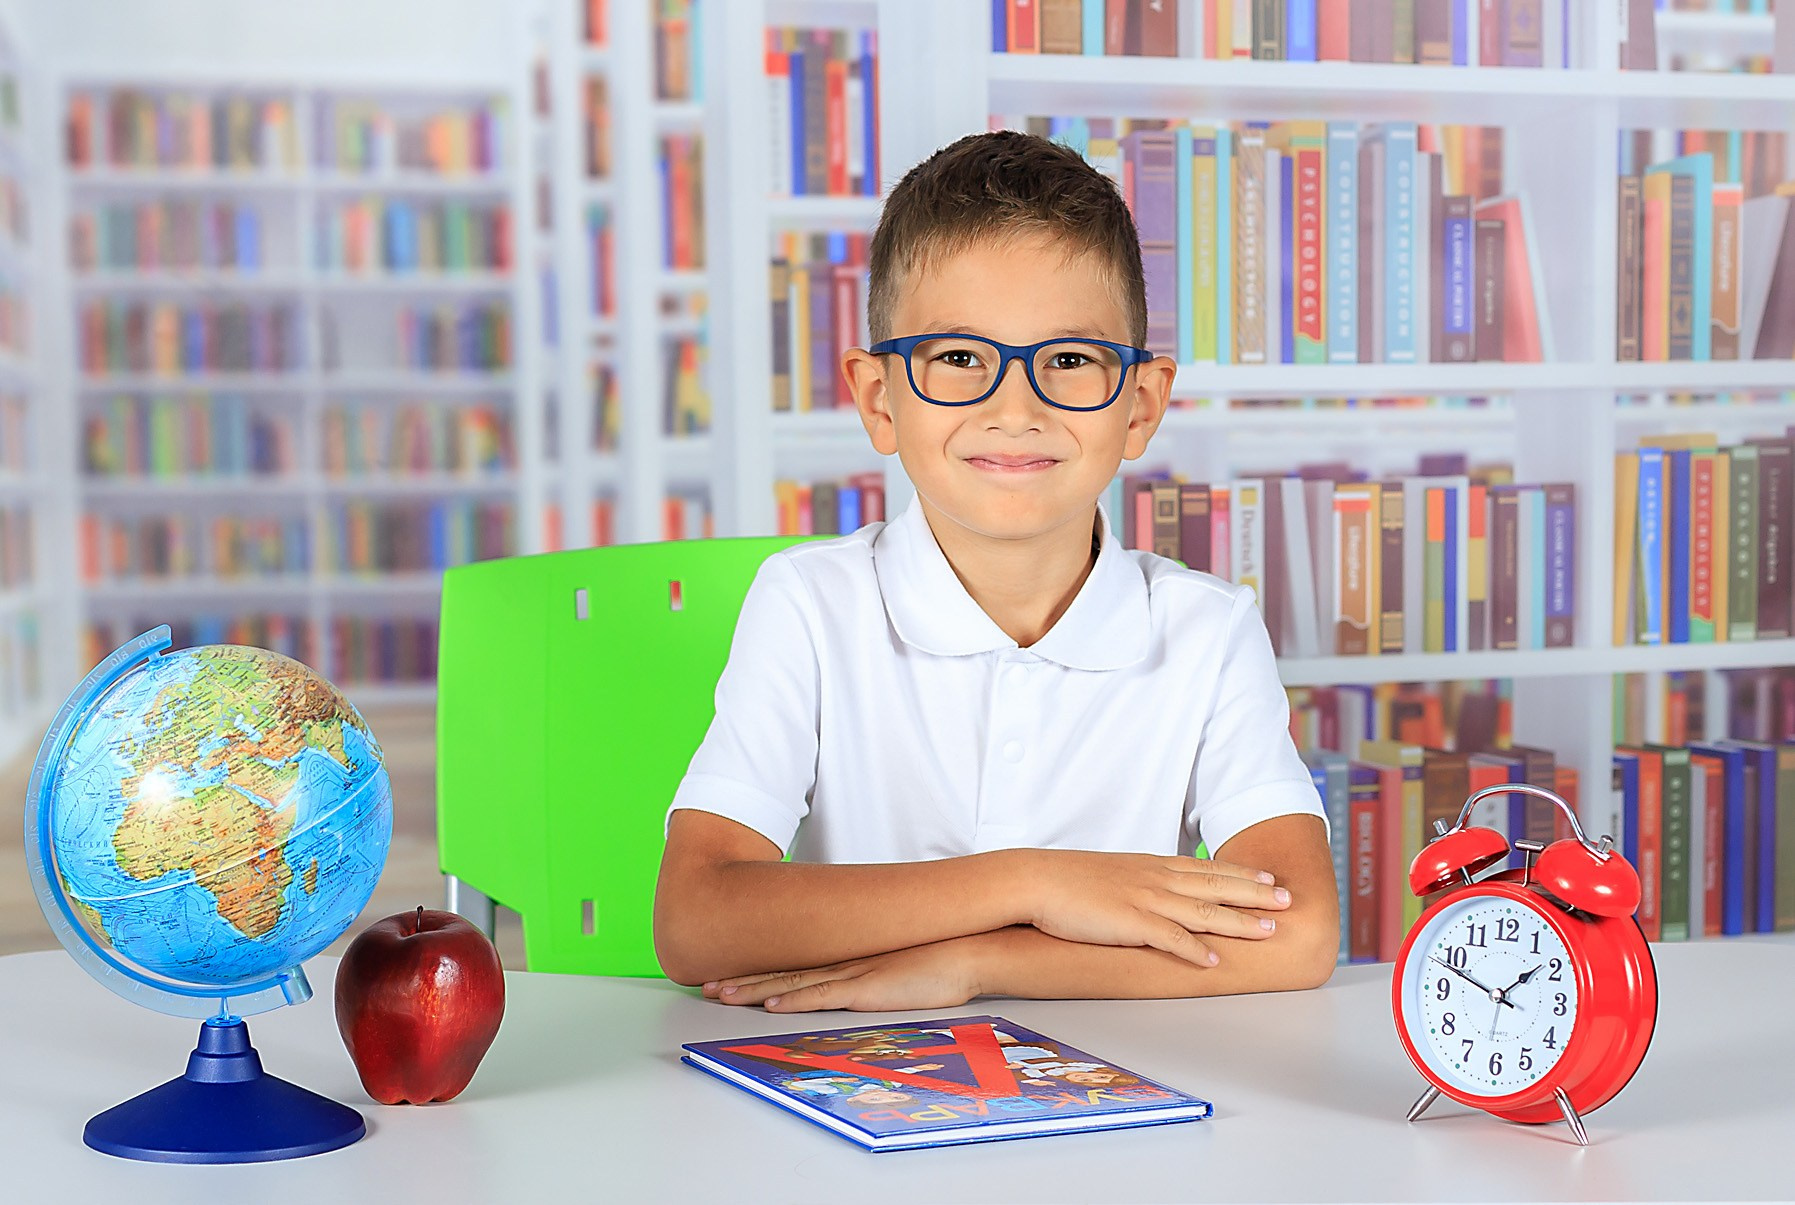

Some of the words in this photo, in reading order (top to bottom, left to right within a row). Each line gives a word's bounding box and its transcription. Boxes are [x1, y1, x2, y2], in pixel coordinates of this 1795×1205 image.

[1302, 166, 1317, 323] PSYCHOLOGY
[1358, 811, 1374, 897] BIOLOGY
[1465, 922, 1488, 948] 11
[1494, 917, 1520, 943] 12
[1529, 930, 1541, 954] 1
[1444, 945, 1467, 969] 10
[1548, 957, 1563, 982] 2
[1437, 977, 1451, 1001] 9
[1553, 992, 1568, 1017] 3
[1441, 1012, 1456, 1036] 8
[1542, 1026, 1557, 1049] 4
[1461, 1038, 1474, 1062] 7
[1518, 1047, 1533, 1071] 5
[1488, 1052, 1503, 1076] 6
[858, 1085, 1173, 1124] БУКВАРЬ
